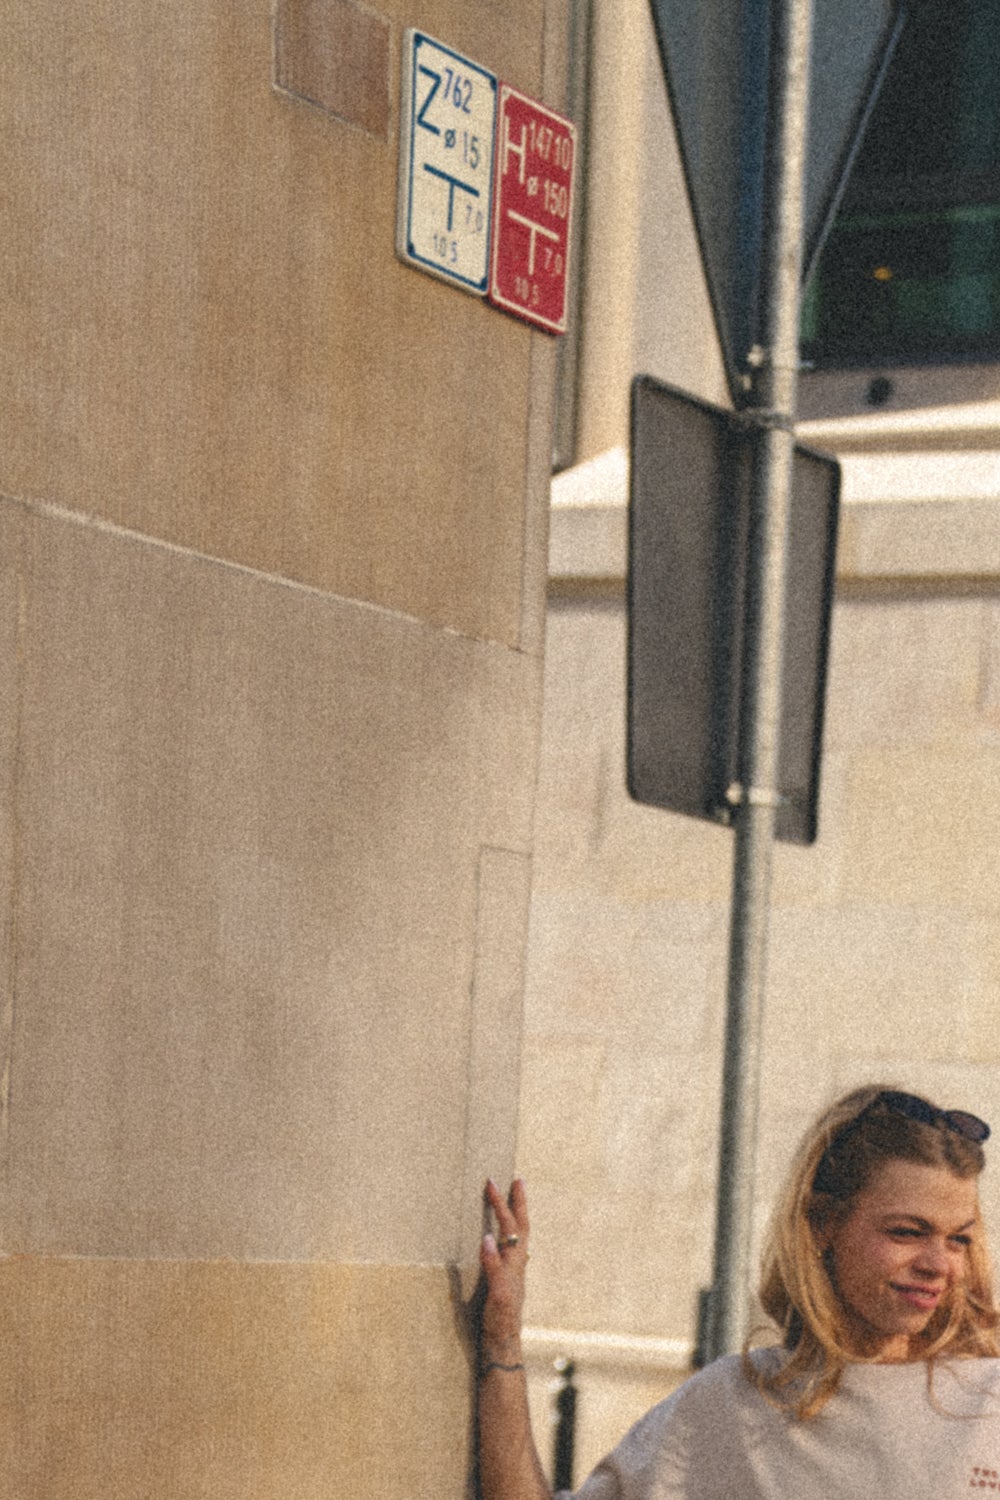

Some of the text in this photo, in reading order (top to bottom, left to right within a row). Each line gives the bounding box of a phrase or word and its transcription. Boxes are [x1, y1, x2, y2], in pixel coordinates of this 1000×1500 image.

[416, 64, 473, 136] Z 762
[463, 131, 481, 170] 15
[503, 115, 527, 185] H
[543, 179, 568, 219] 150
